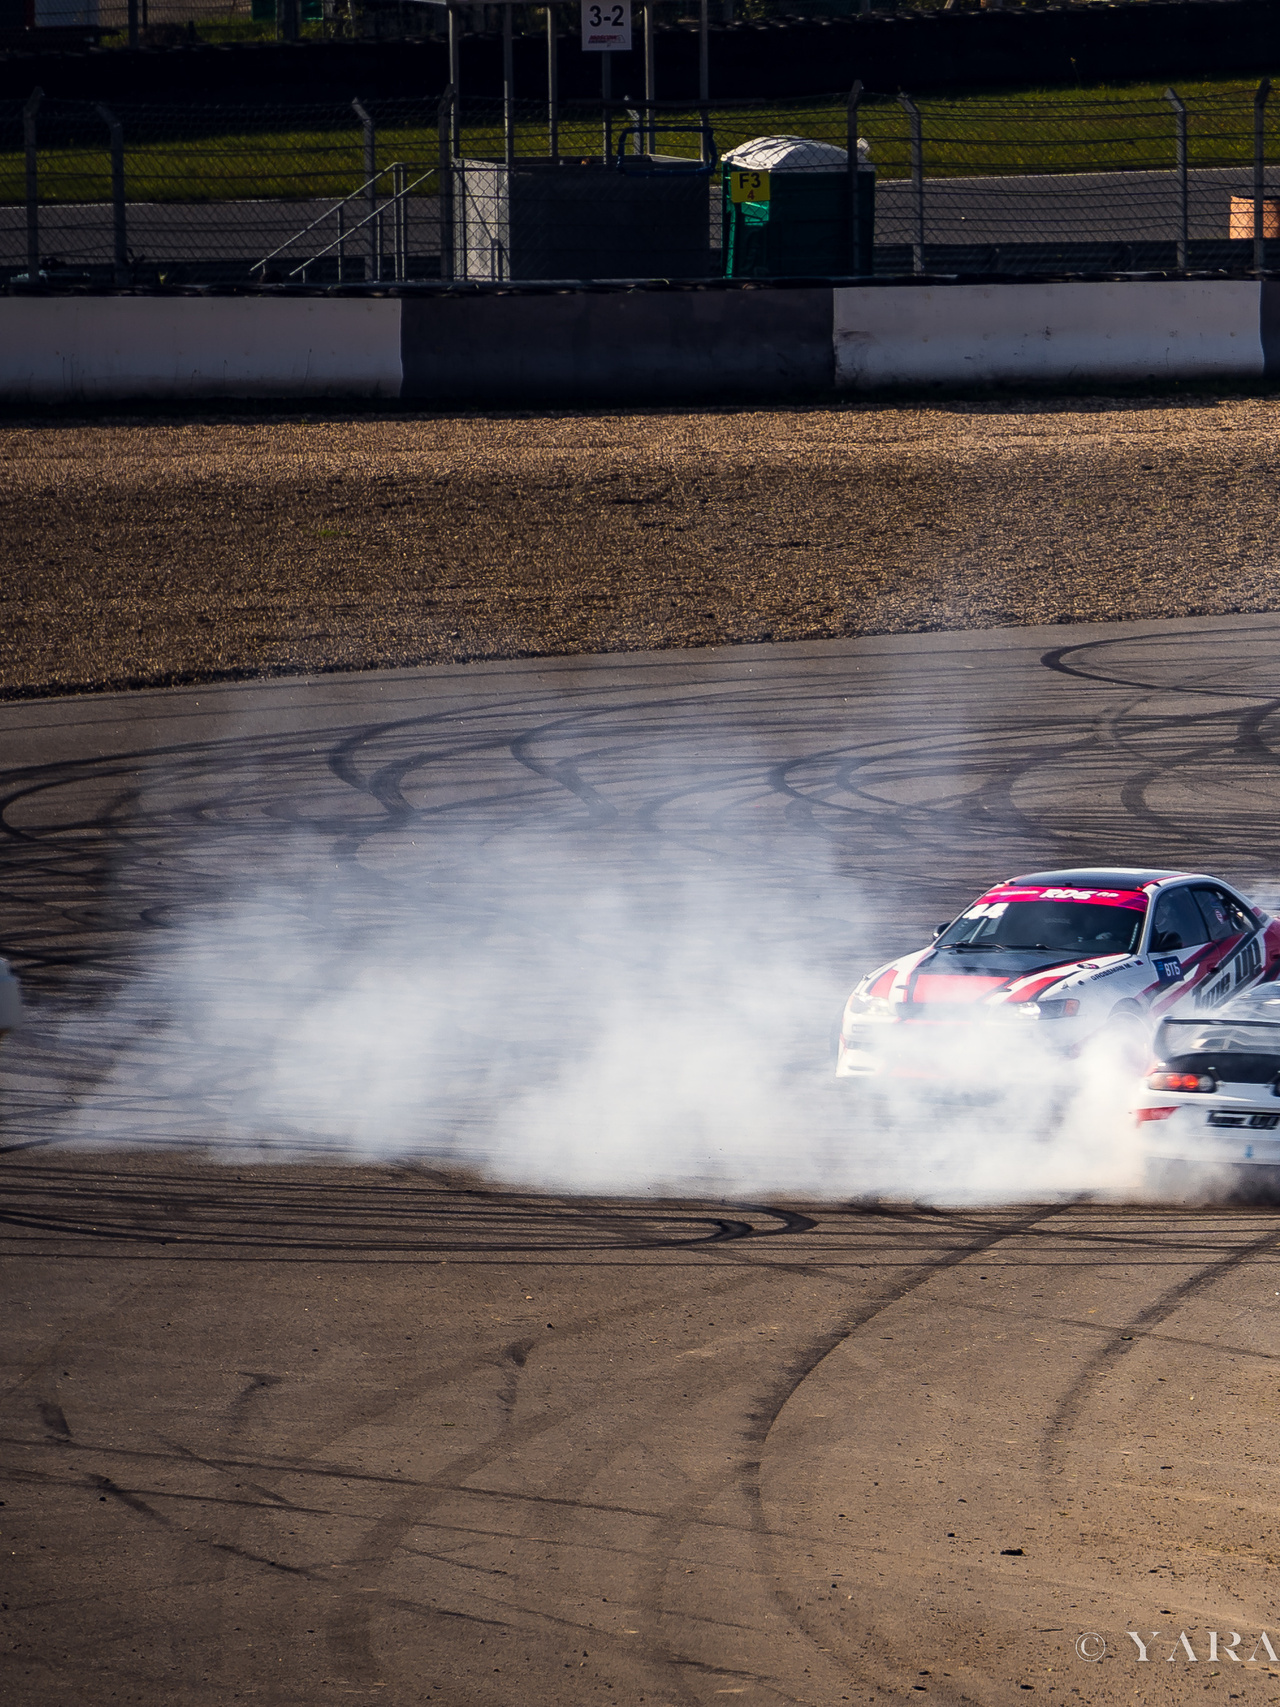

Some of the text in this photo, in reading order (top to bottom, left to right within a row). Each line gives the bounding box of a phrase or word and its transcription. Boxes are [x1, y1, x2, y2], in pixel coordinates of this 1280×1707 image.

[589, 4, 624, 27] 3-2
[739, 172, 761, 189] F3
[747, 189, 755, 200] 4
[1039, 888, 1098, 900] RDS
[962, 903, 1009, 919] 44
